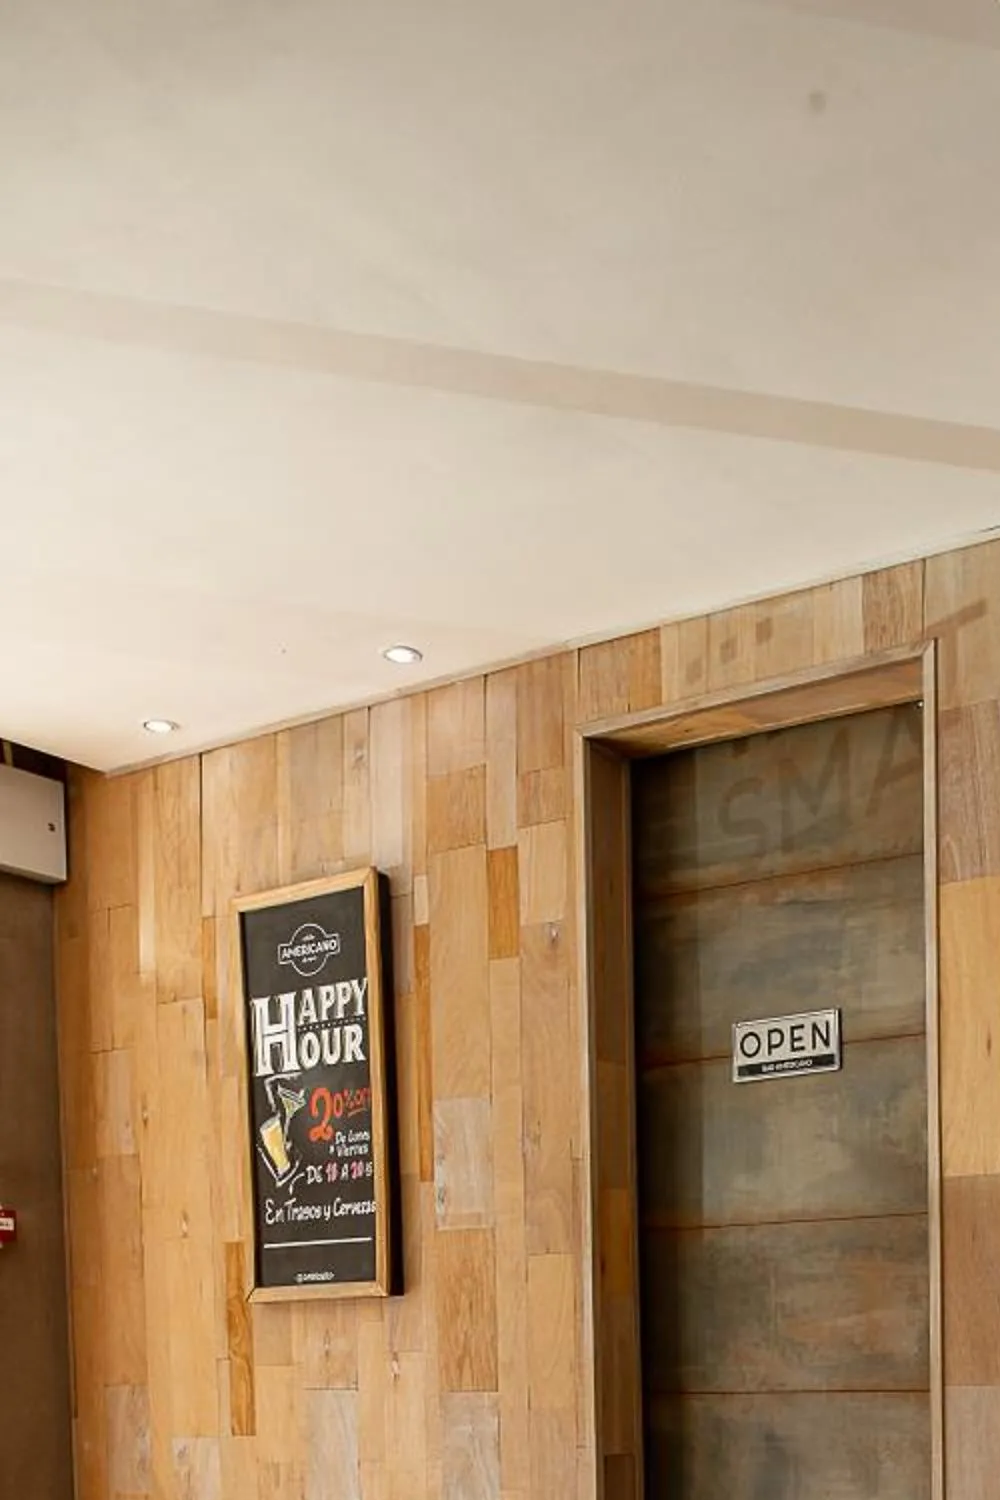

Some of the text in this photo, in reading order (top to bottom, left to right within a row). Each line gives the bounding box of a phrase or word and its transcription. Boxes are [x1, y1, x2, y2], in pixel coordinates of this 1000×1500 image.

[282, 939, 337, 960] AMERICANO
[250, 977, 367, 1077] HAPPY
[740, 1020, 830, 1058] OPEN
